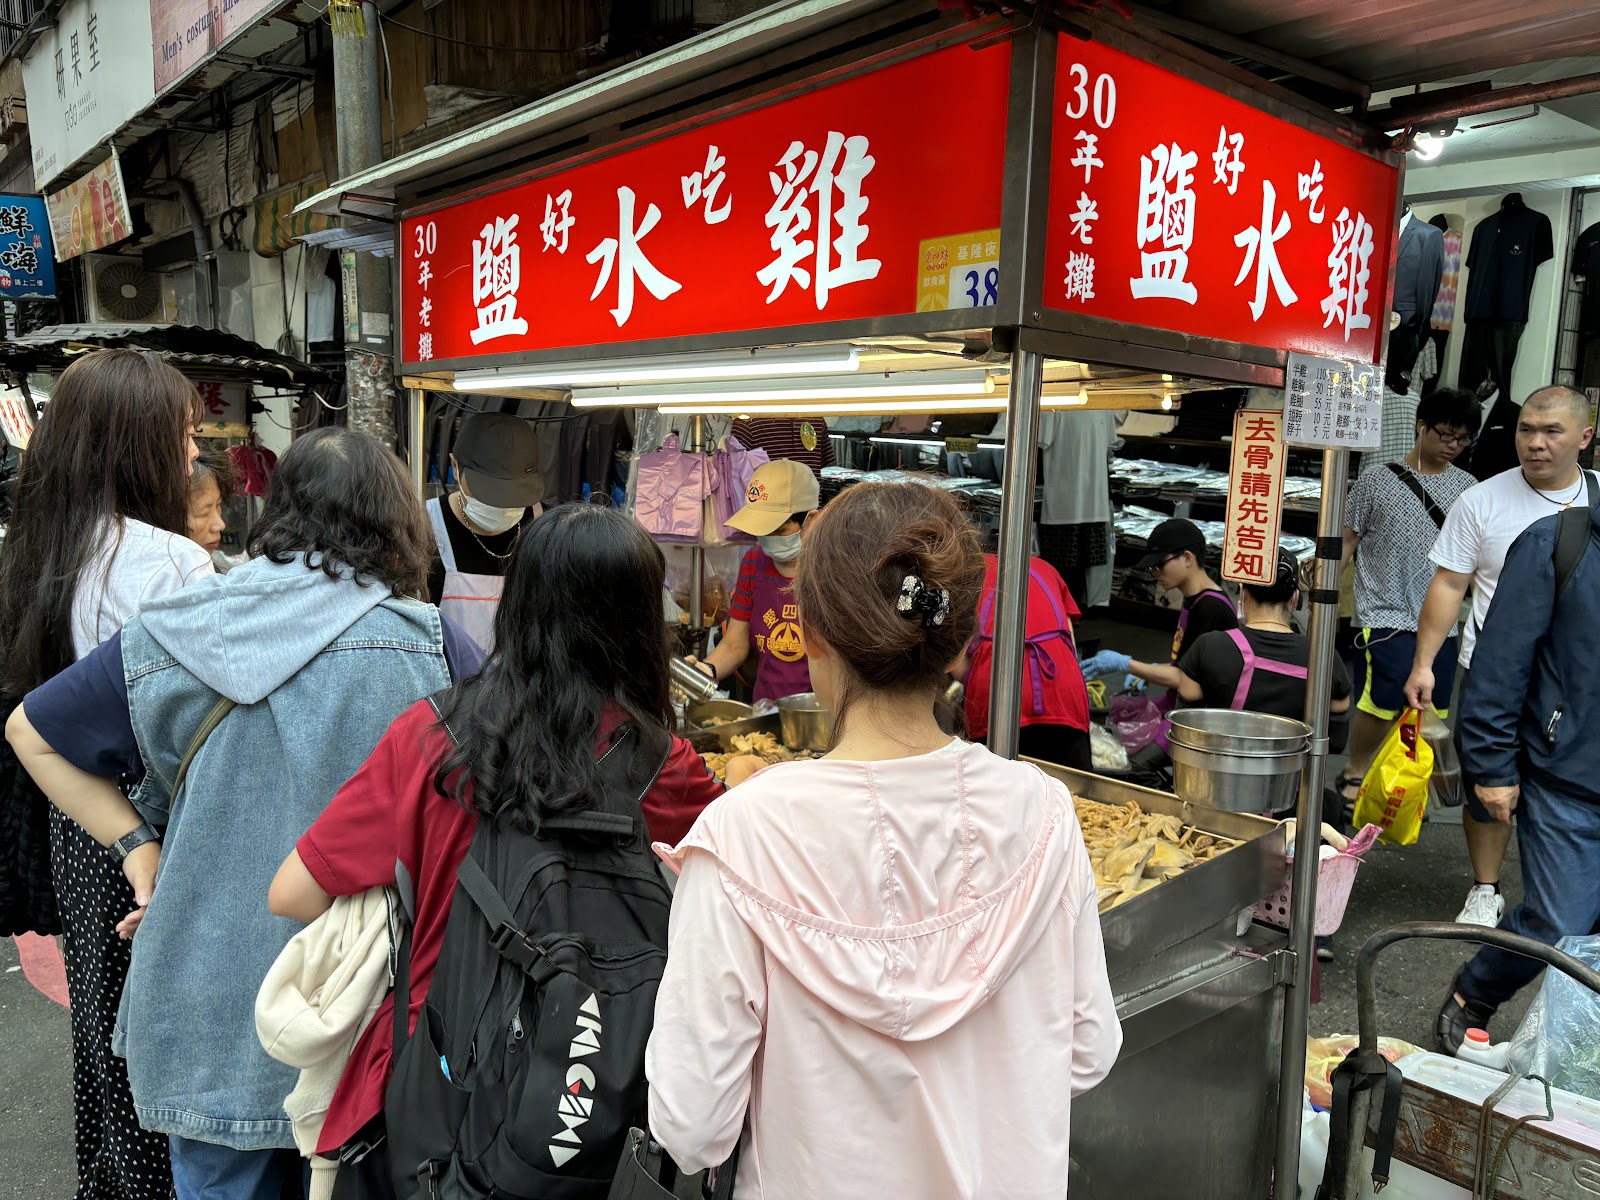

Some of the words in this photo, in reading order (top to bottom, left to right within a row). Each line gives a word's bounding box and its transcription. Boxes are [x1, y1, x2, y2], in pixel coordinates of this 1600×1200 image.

[162, 32, 183, 64] Men's
[186, 5, 219, 44] costume
[923, 274, 947, 287] 飲食區
[1232, 417, 1275, 577] 去骨請先告知
